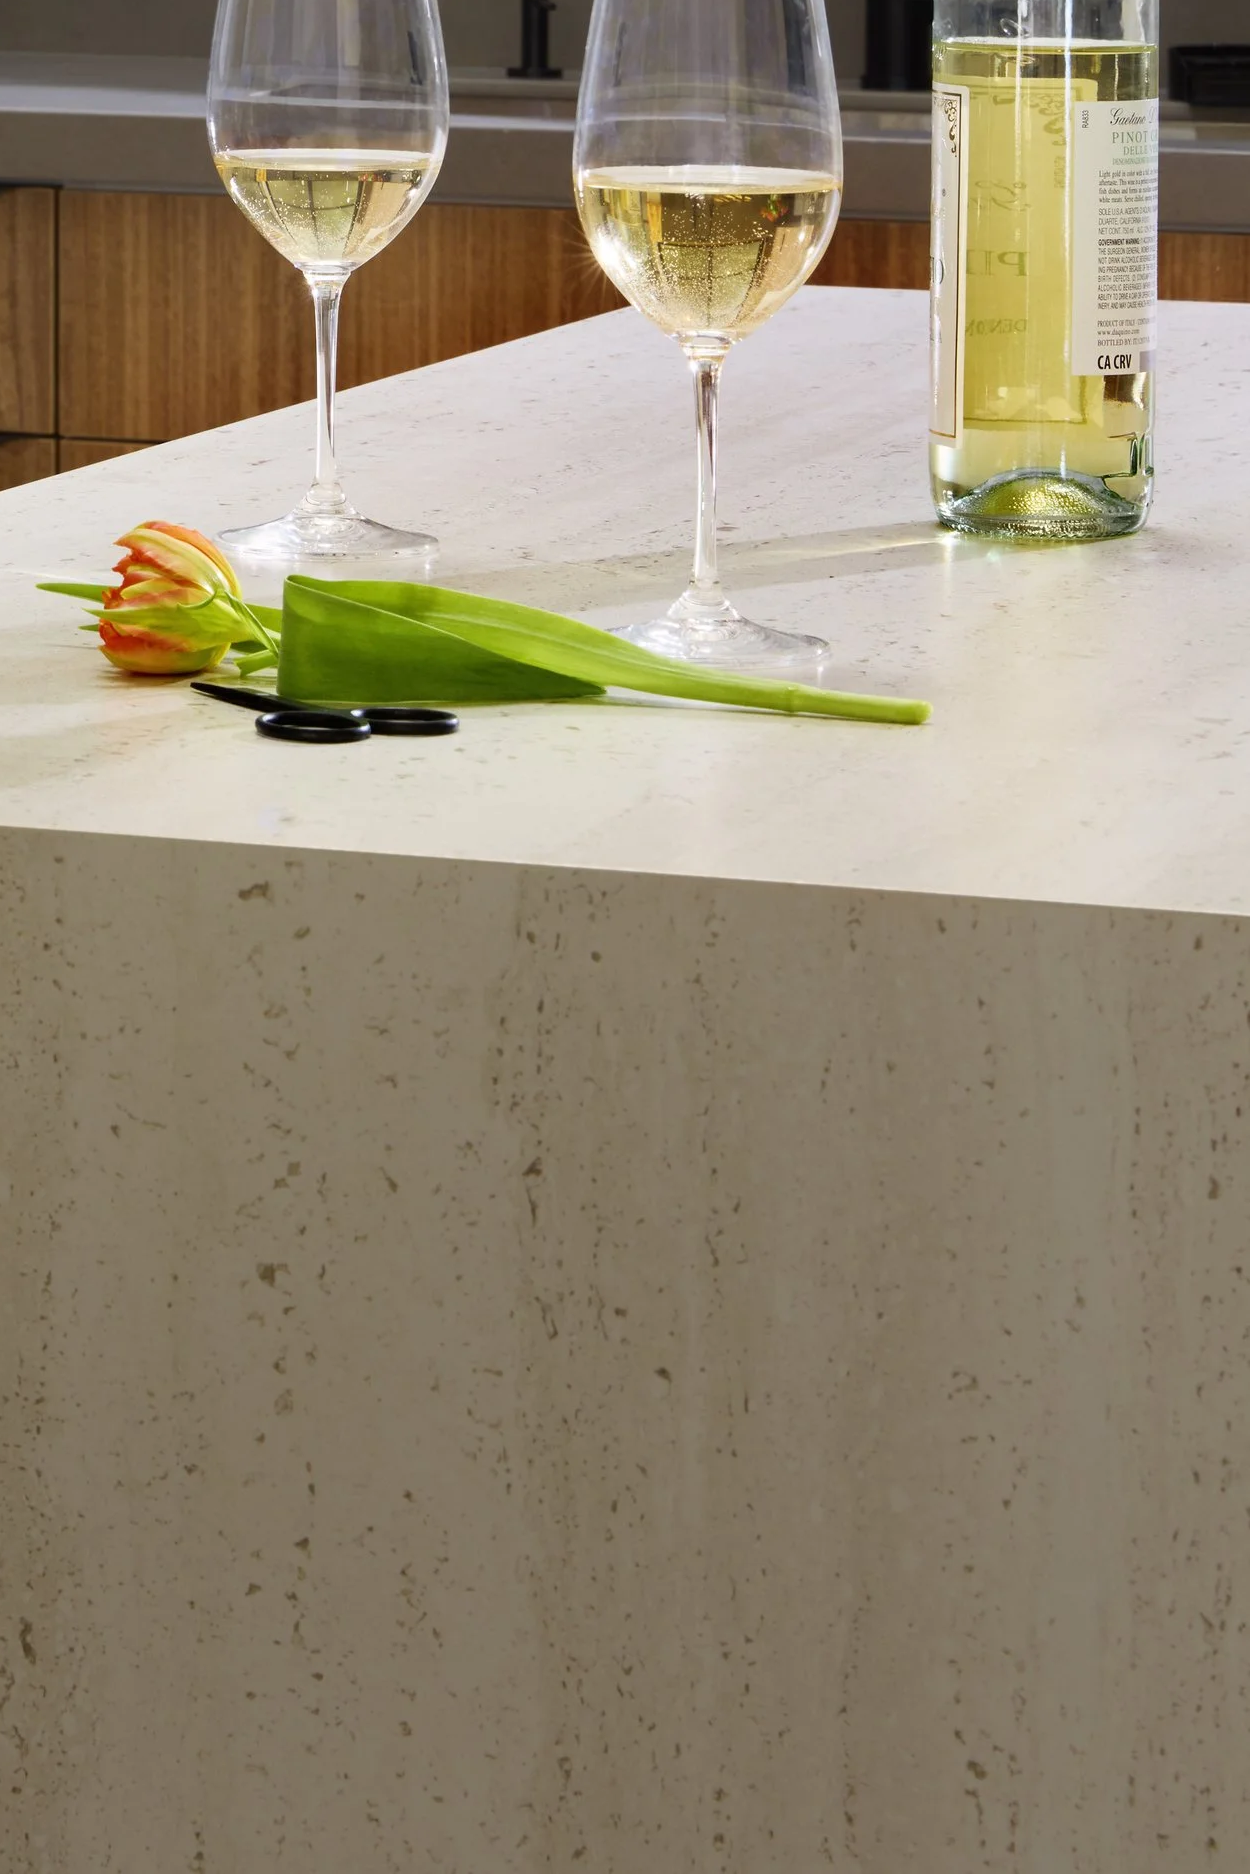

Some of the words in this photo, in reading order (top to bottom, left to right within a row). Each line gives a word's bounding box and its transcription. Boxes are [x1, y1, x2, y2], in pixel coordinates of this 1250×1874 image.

[1110, 107, 1146, 126] Gaetano
[1112, 131, 1148, 144] PINOT
[1123, 146, 1148, 156] DELLE
[1099, 171, 1111, 179] Light
[1112, 171, 1121, 179] gold
[1099, 208, 1111, 216] SOLE
[1098, 227, 1107, 235] NET
[1098, 238, 1125, 246] GOVERNMENT
[1098, 247, 1107, 255] THE
[1107, 247, 1125, 255] SURGEON
[1098, 257, 1107, 265] NOT
[1108, 256, 1120, 264] DRINK
[1106, 265, 1129, 273] PREGNANCY
[1098, 284, 1122, 292] ALCOHOLIC
[1098, 293, 1112, 301] ABILITY
[1098, 319, 1118, 327] PRODUCT
[1119, 319, 1125, 327] OF
[1097, 339, 1124, 347] BOTTLED
[1097, 356, 1111, 370] CA
[1113, 355, 1132, 369] CRV
